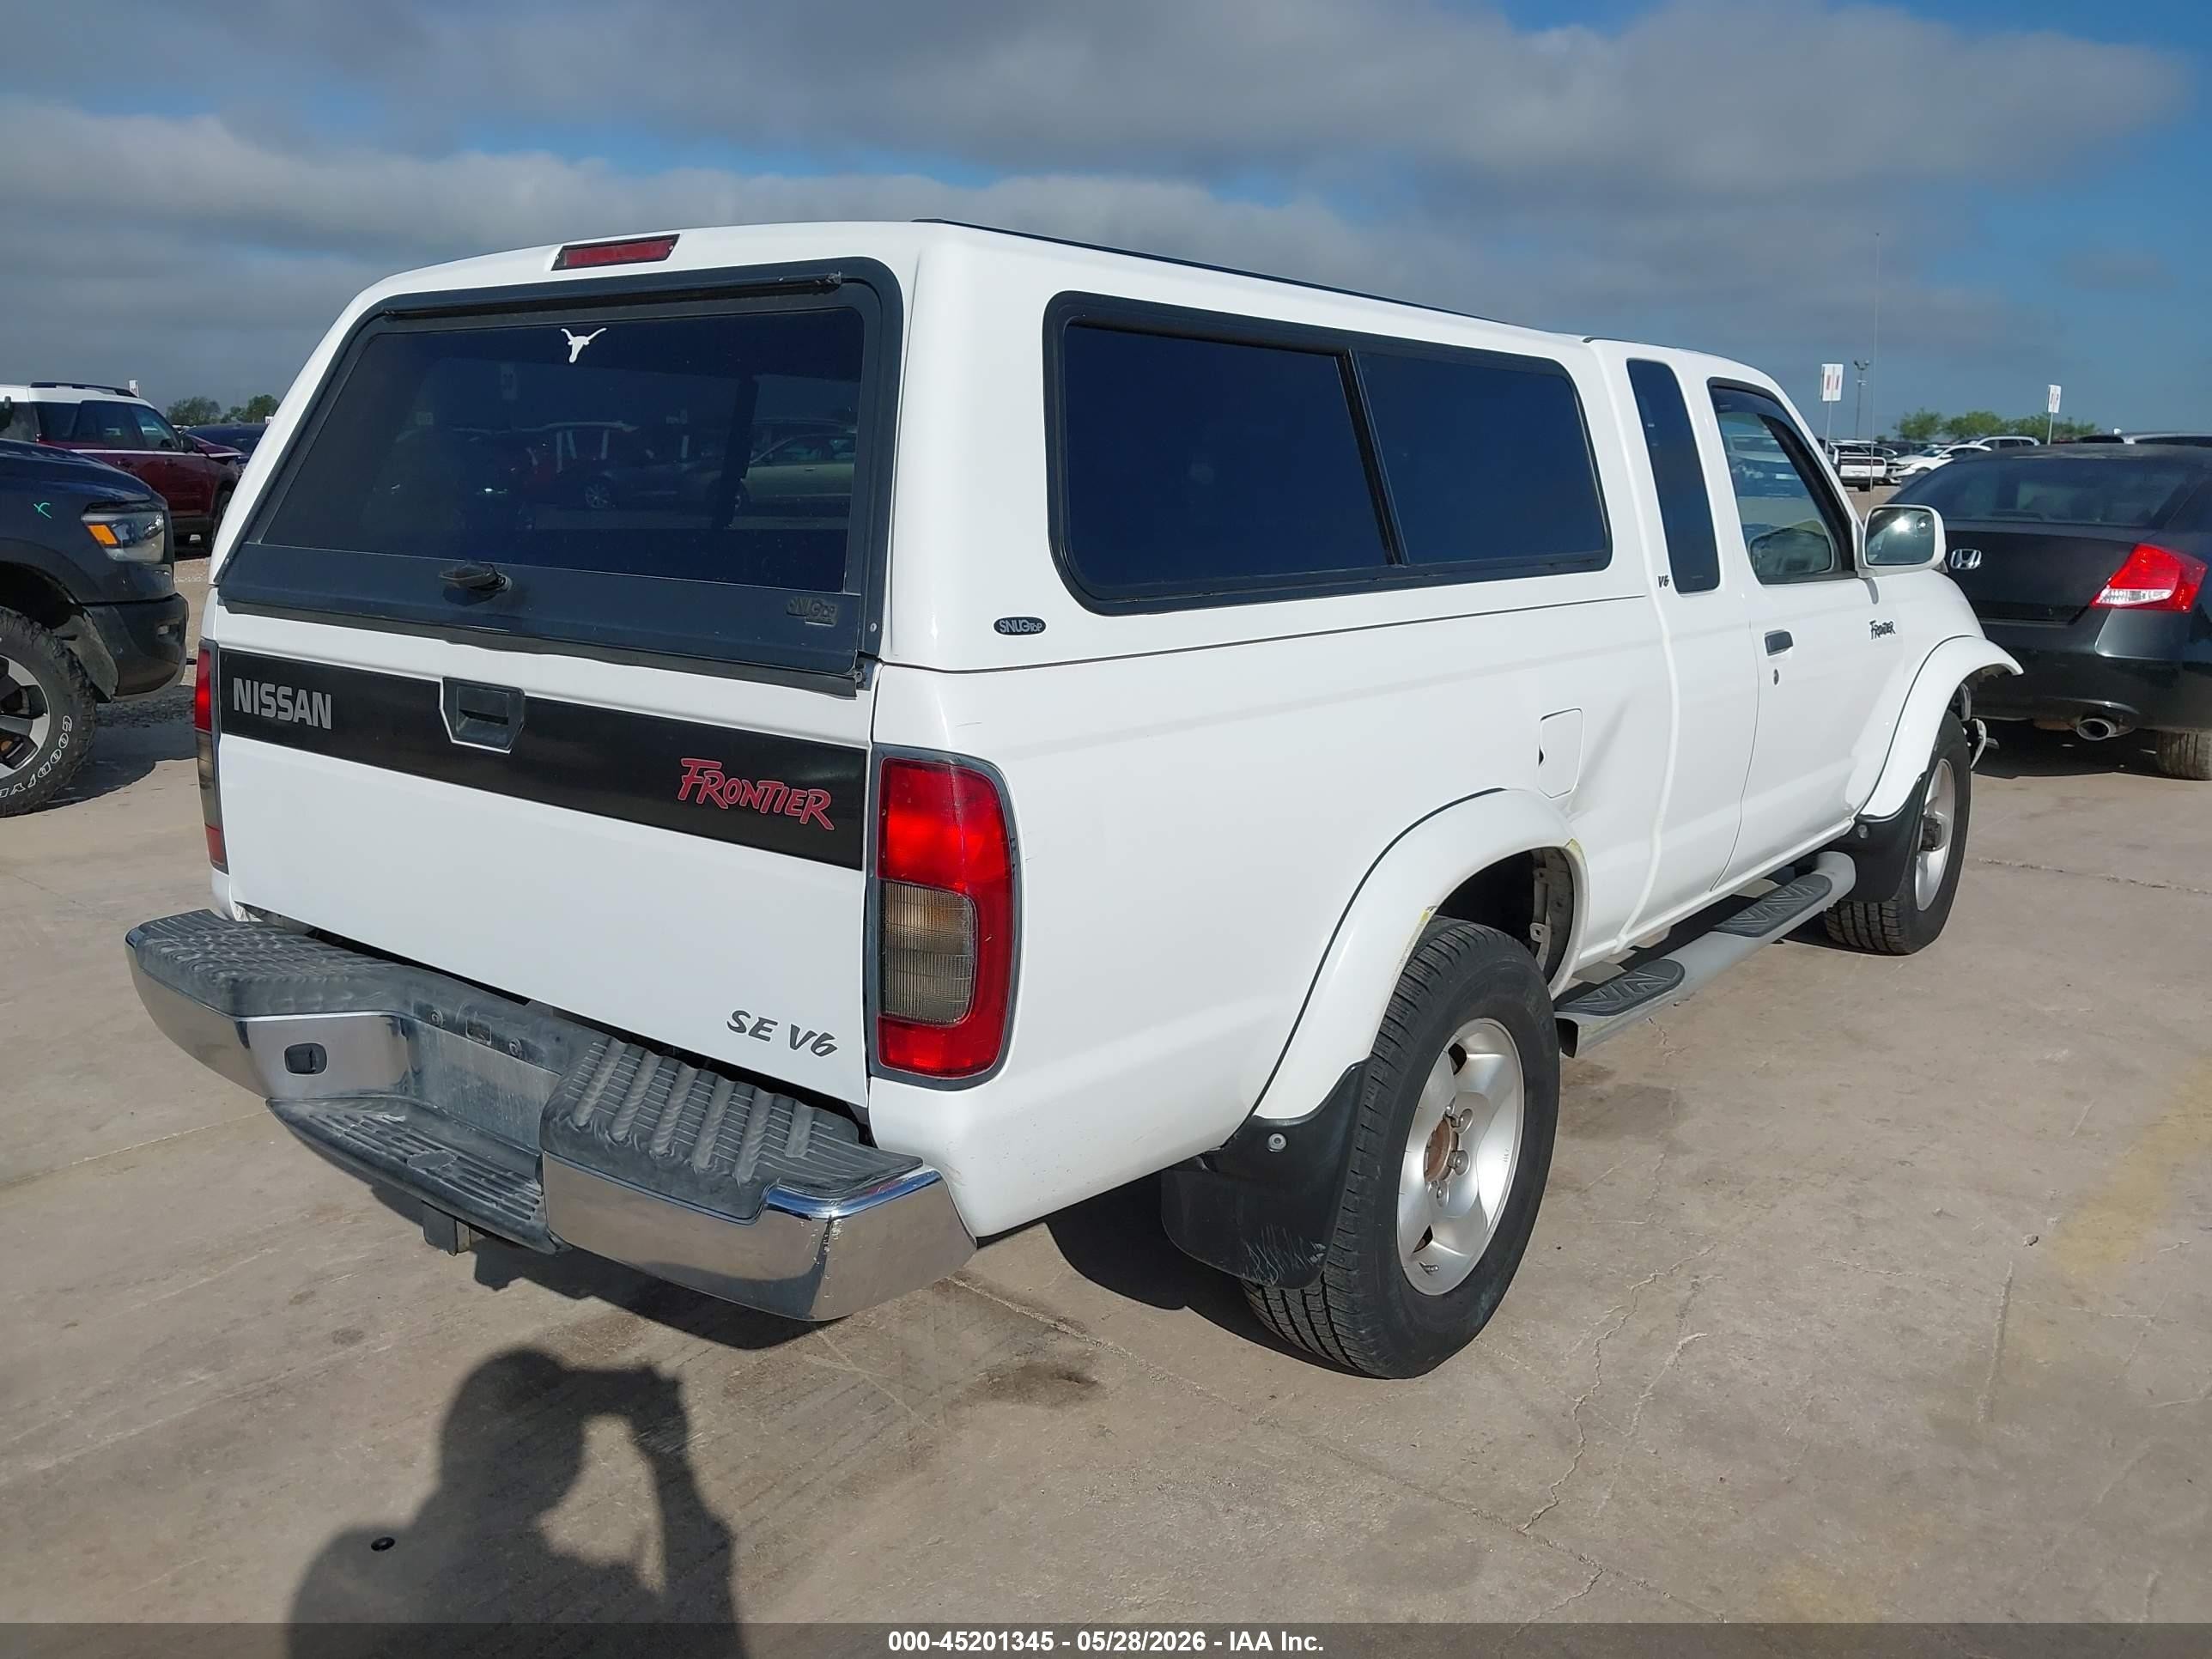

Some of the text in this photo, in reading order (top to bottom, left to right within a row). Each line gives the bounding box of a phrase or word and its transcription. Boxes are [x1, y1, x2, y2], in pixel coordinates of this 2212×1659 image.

[1657, 574, 1670, 588] V6
[233, 677, 332, 730] NISSAN
[678, 757, 835, 831] FRONTIER
[726, 1010, 838, 1057] SE V6
